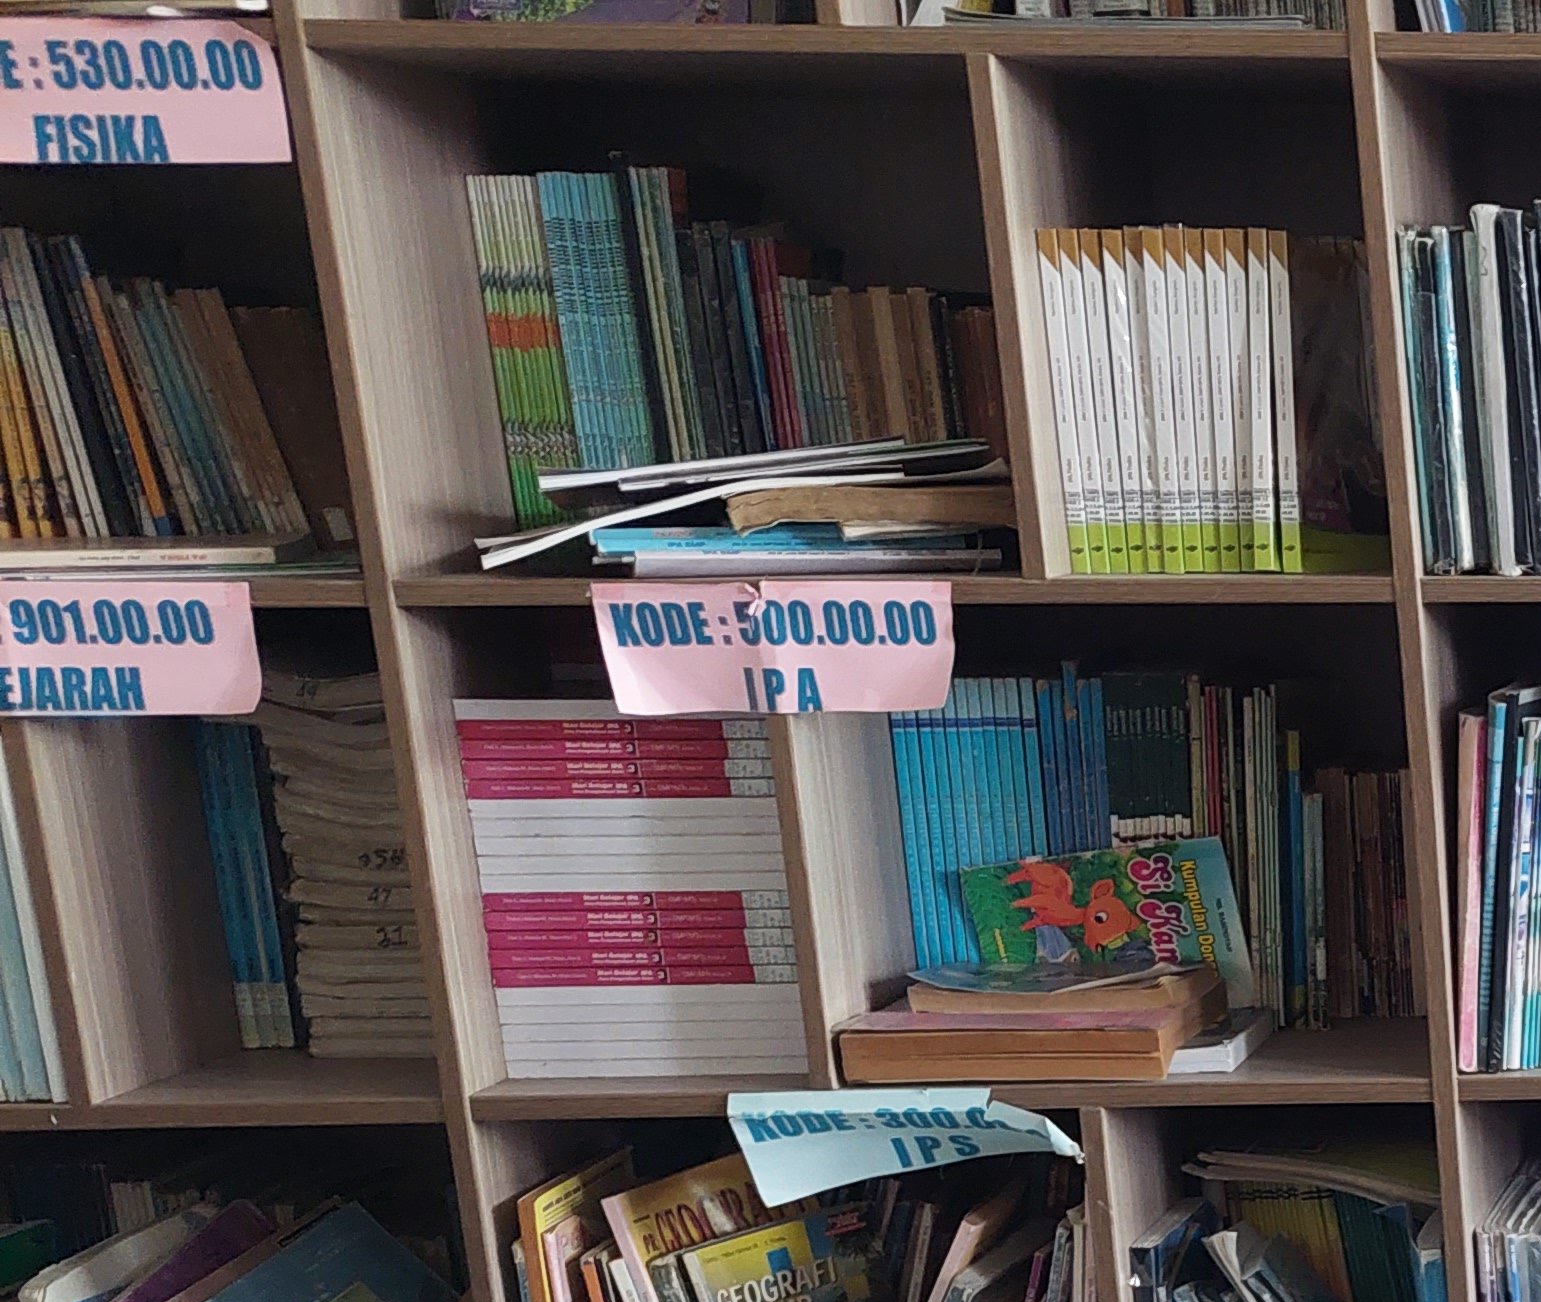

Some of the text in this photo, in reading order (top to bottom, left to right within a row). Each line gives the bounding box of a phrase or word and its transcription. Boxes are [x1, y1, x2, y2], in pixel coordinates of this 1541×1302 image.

[46, 39, 263, 91] 530.00.00
[34, 114, 169, 162] FISIKA
[9, 599, 214, 645] 901.00.00
[610, 603, 714, 647] KODE
[0, 667, 145, 711] EJARAH
[1180, 860, 1208, 931] Kumpulan
